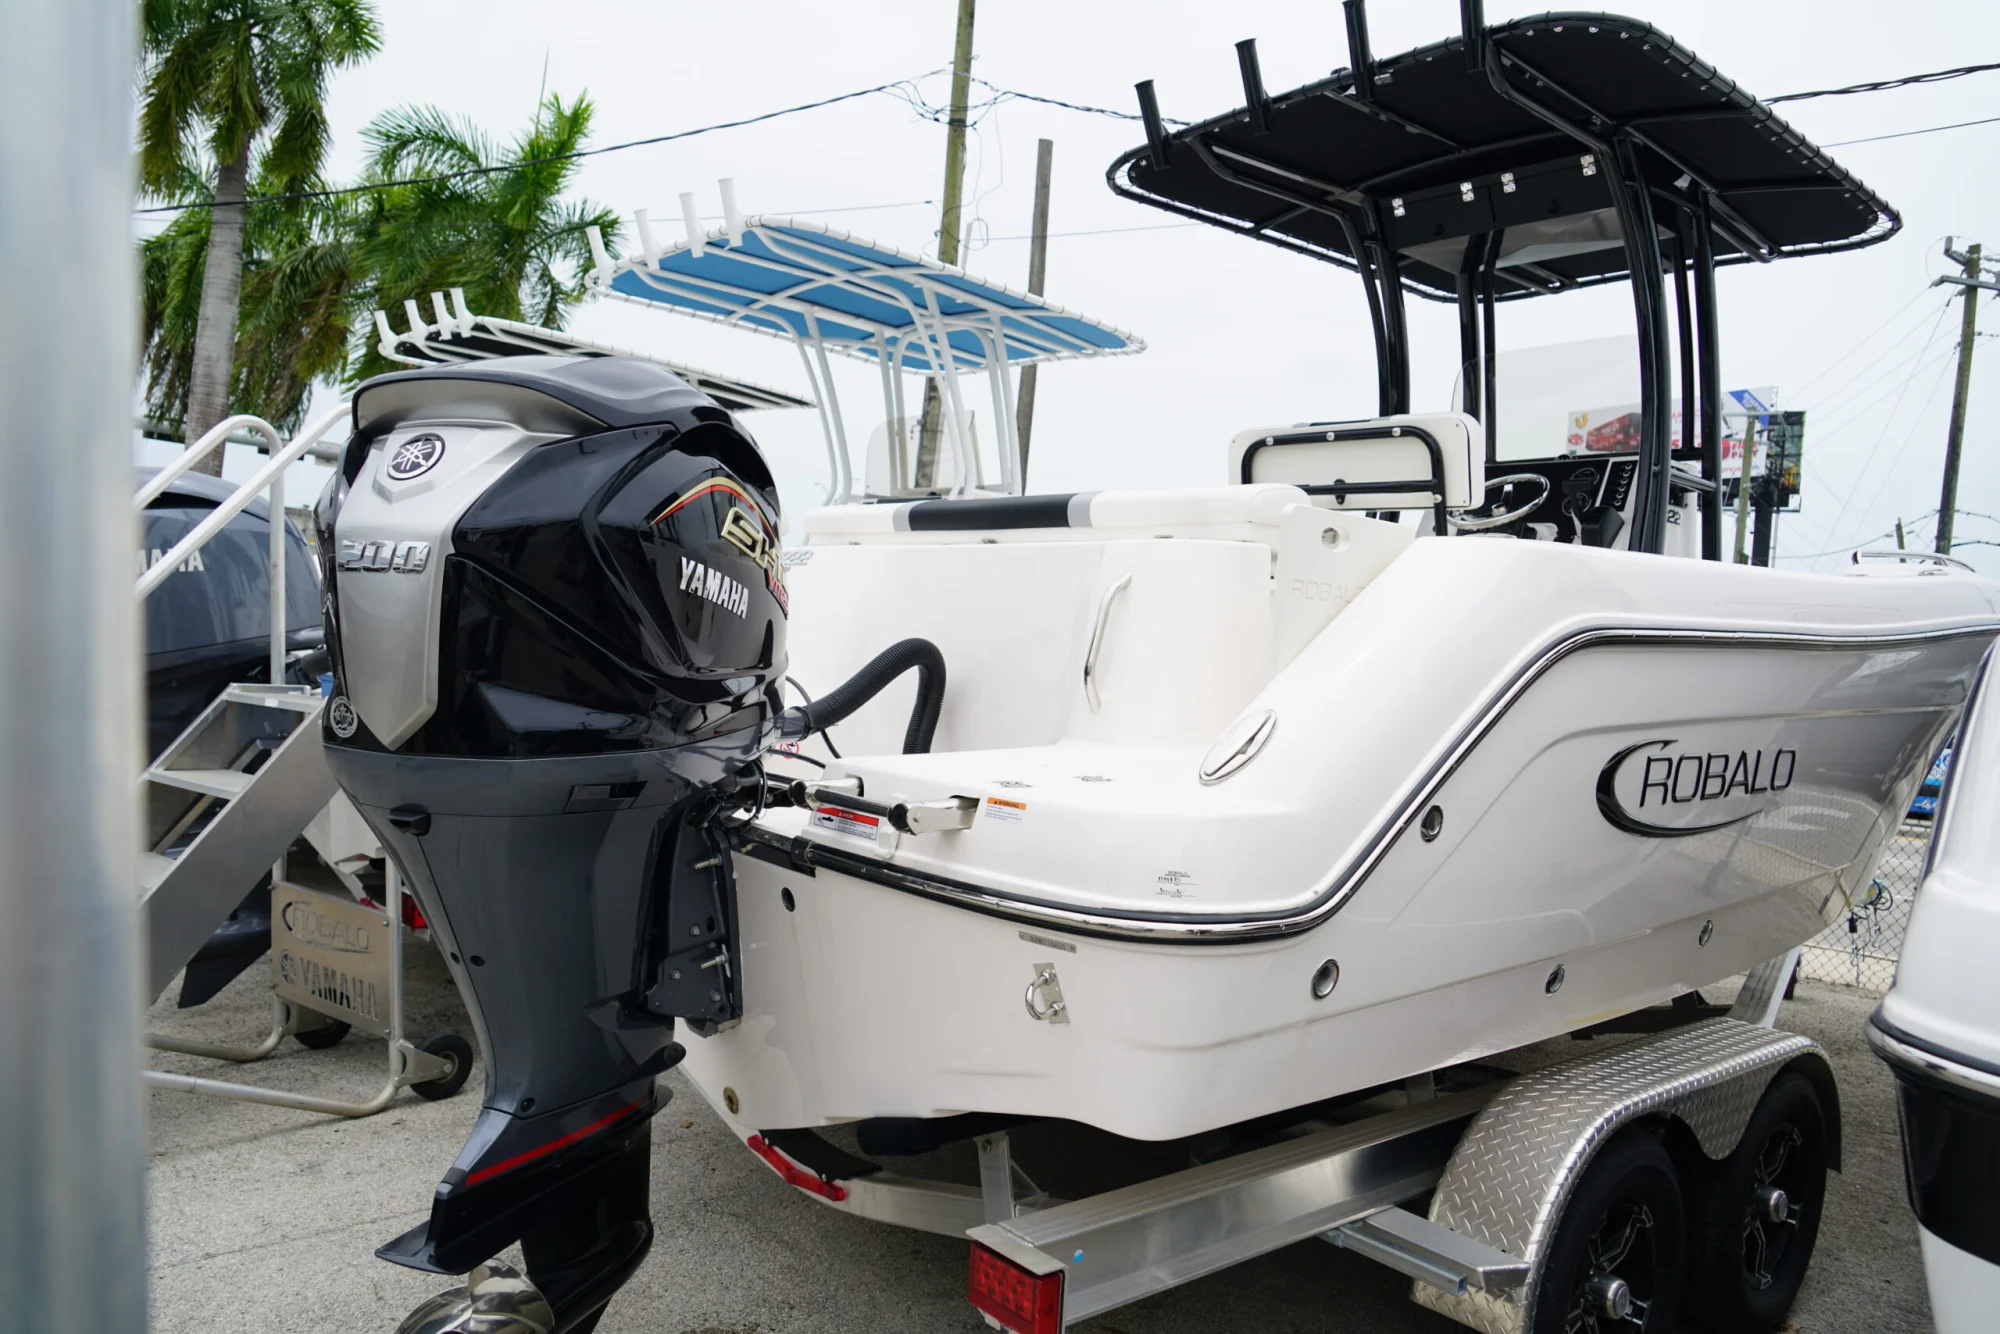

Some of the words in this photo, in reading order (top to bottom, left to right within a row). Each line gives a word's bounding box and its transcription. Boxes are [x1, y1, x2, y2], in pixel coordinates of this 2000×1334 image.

[338, 540, 431, 574] 200
[679, 556, 749, 619] YAMAHA
[1639, 748, 1796, 808] ROBALO
[292, 906, 370, 950] ROBALO
[299, 957, 379, 1022] YAMAHA
